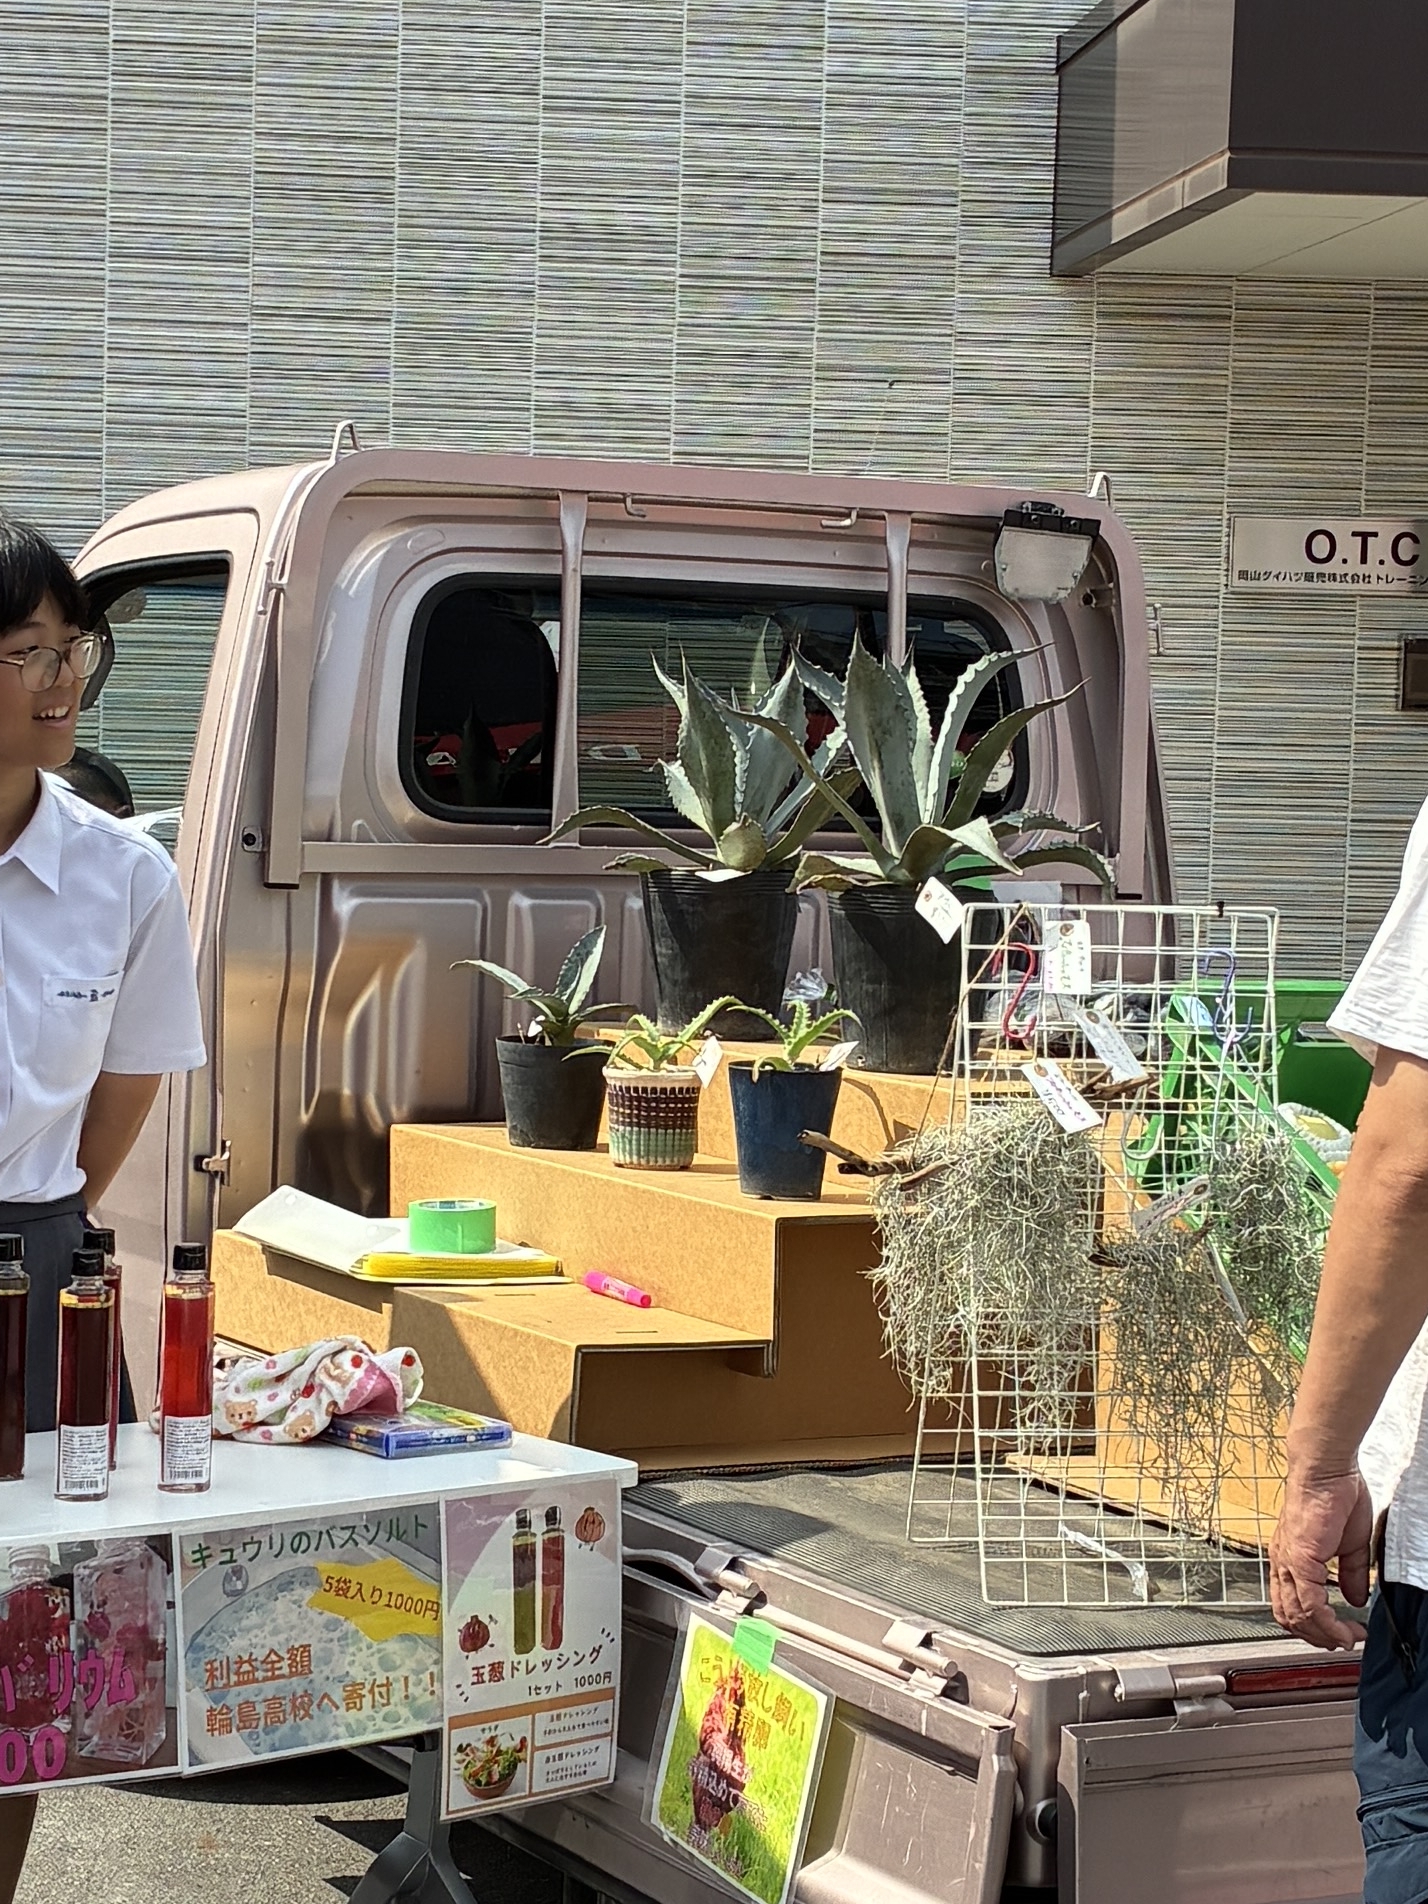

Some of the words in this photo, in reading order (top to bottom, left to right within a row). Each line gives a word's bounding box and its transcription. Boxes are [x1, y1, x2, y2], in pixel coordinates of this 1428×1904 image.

[1305, 529, 1421, 567] O.T.C
[190, 1512, 430, 1569] キュウリのバスソルト
[203, 1643, 313, 1691] 利益全額
